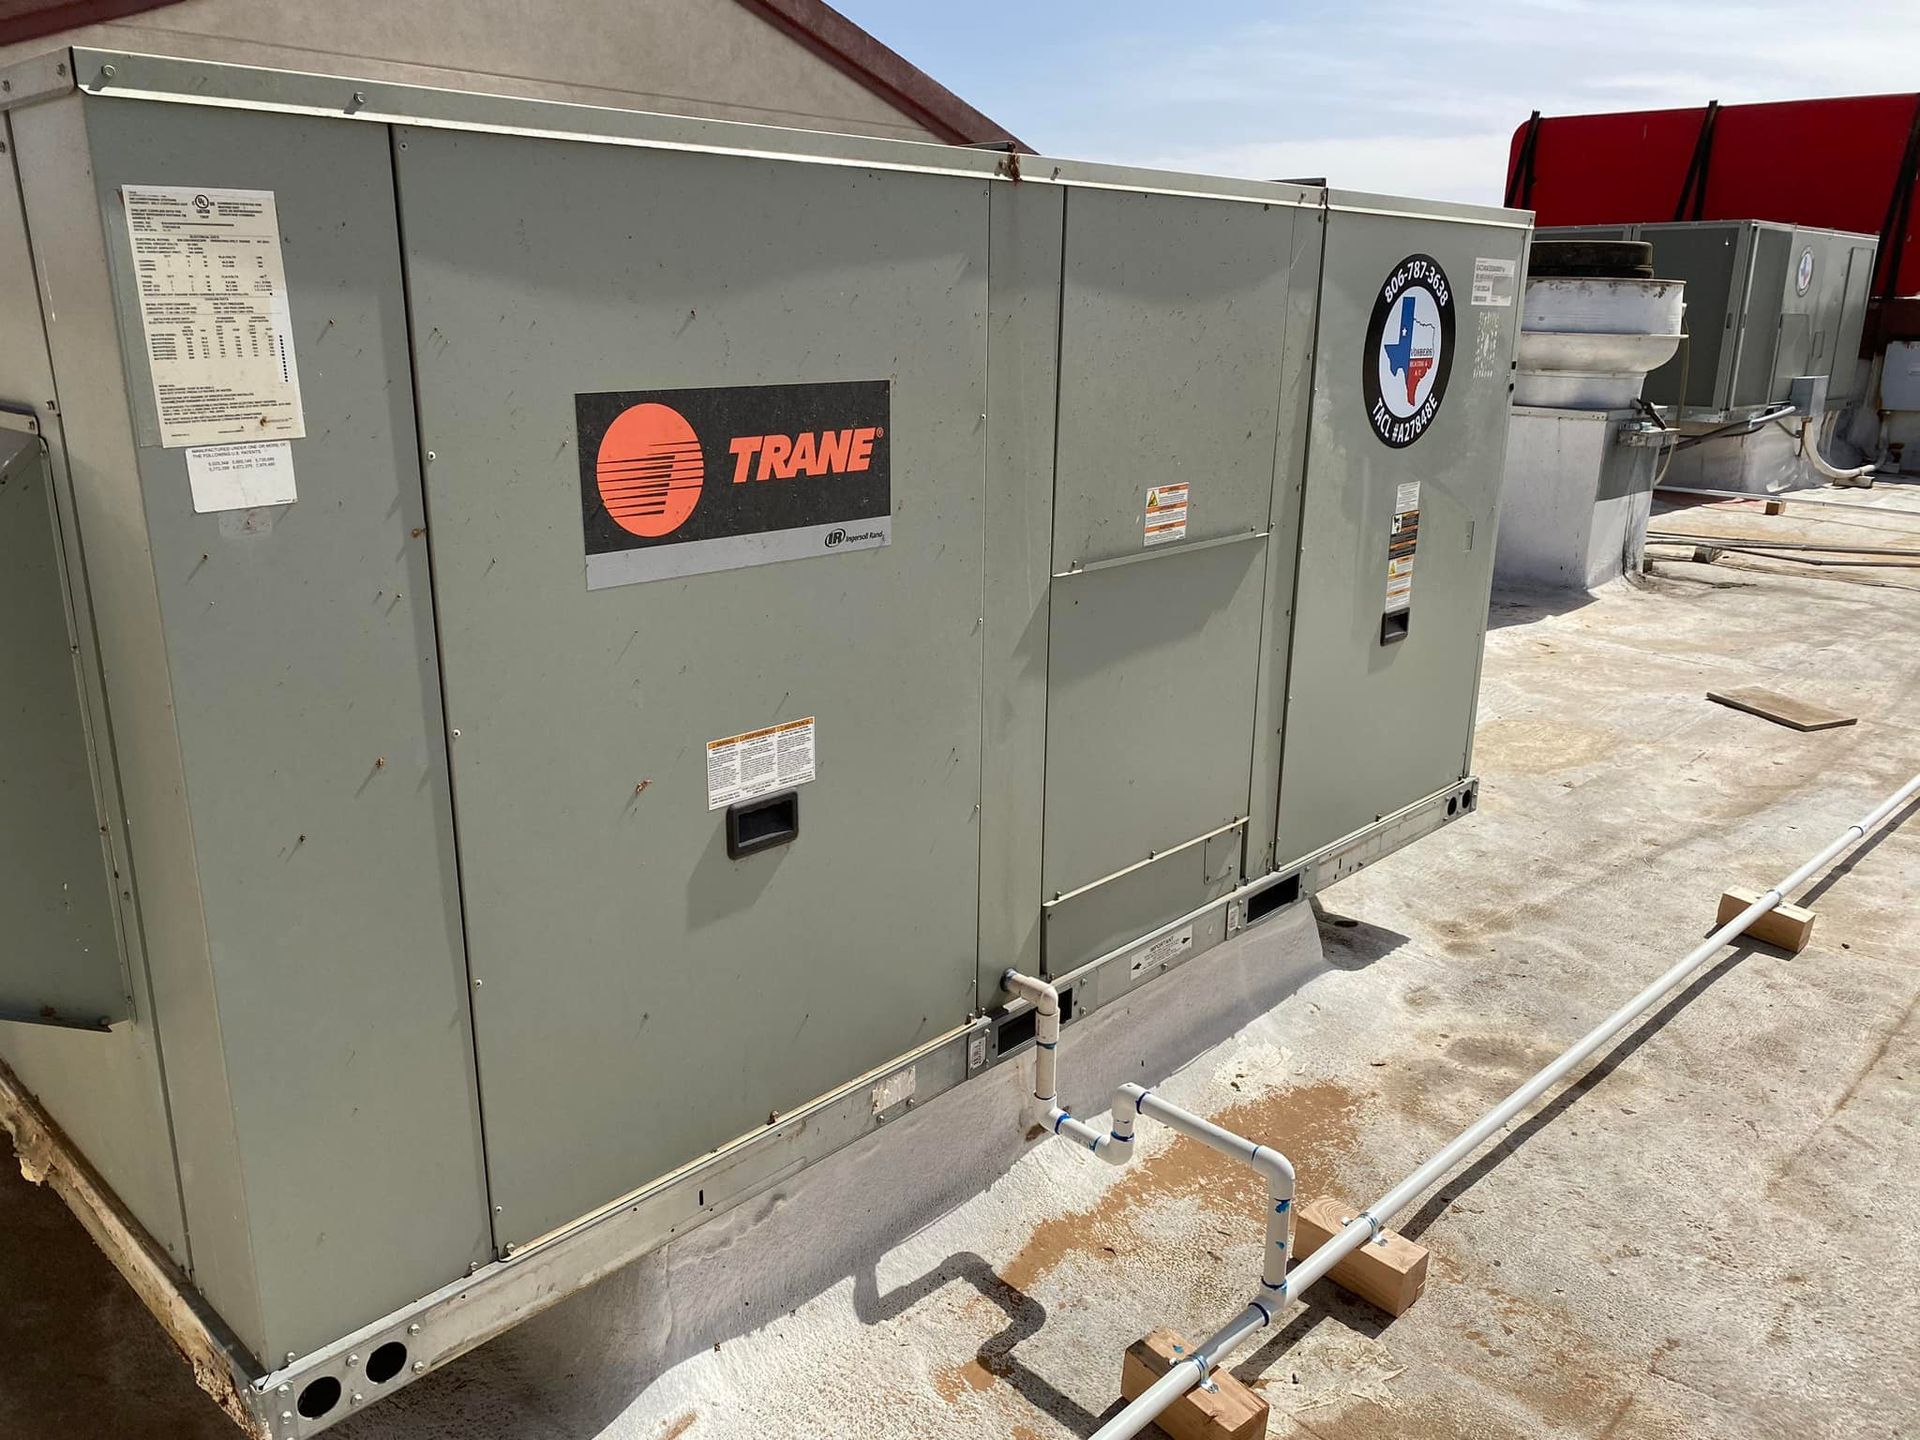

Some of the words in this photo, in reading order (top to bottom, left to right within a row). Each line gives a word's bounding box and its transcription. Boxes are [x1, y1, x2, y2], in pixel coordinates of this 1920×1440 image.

[1384, 260, 1449, 306] 806-787-3638
[1372, 397, 1392, 438] TACL
[1391, 393, 1438, 443] #A27848E
[728, 427, 877, 484] TRANE
[846, 532, 869, 544] Ingersoll
